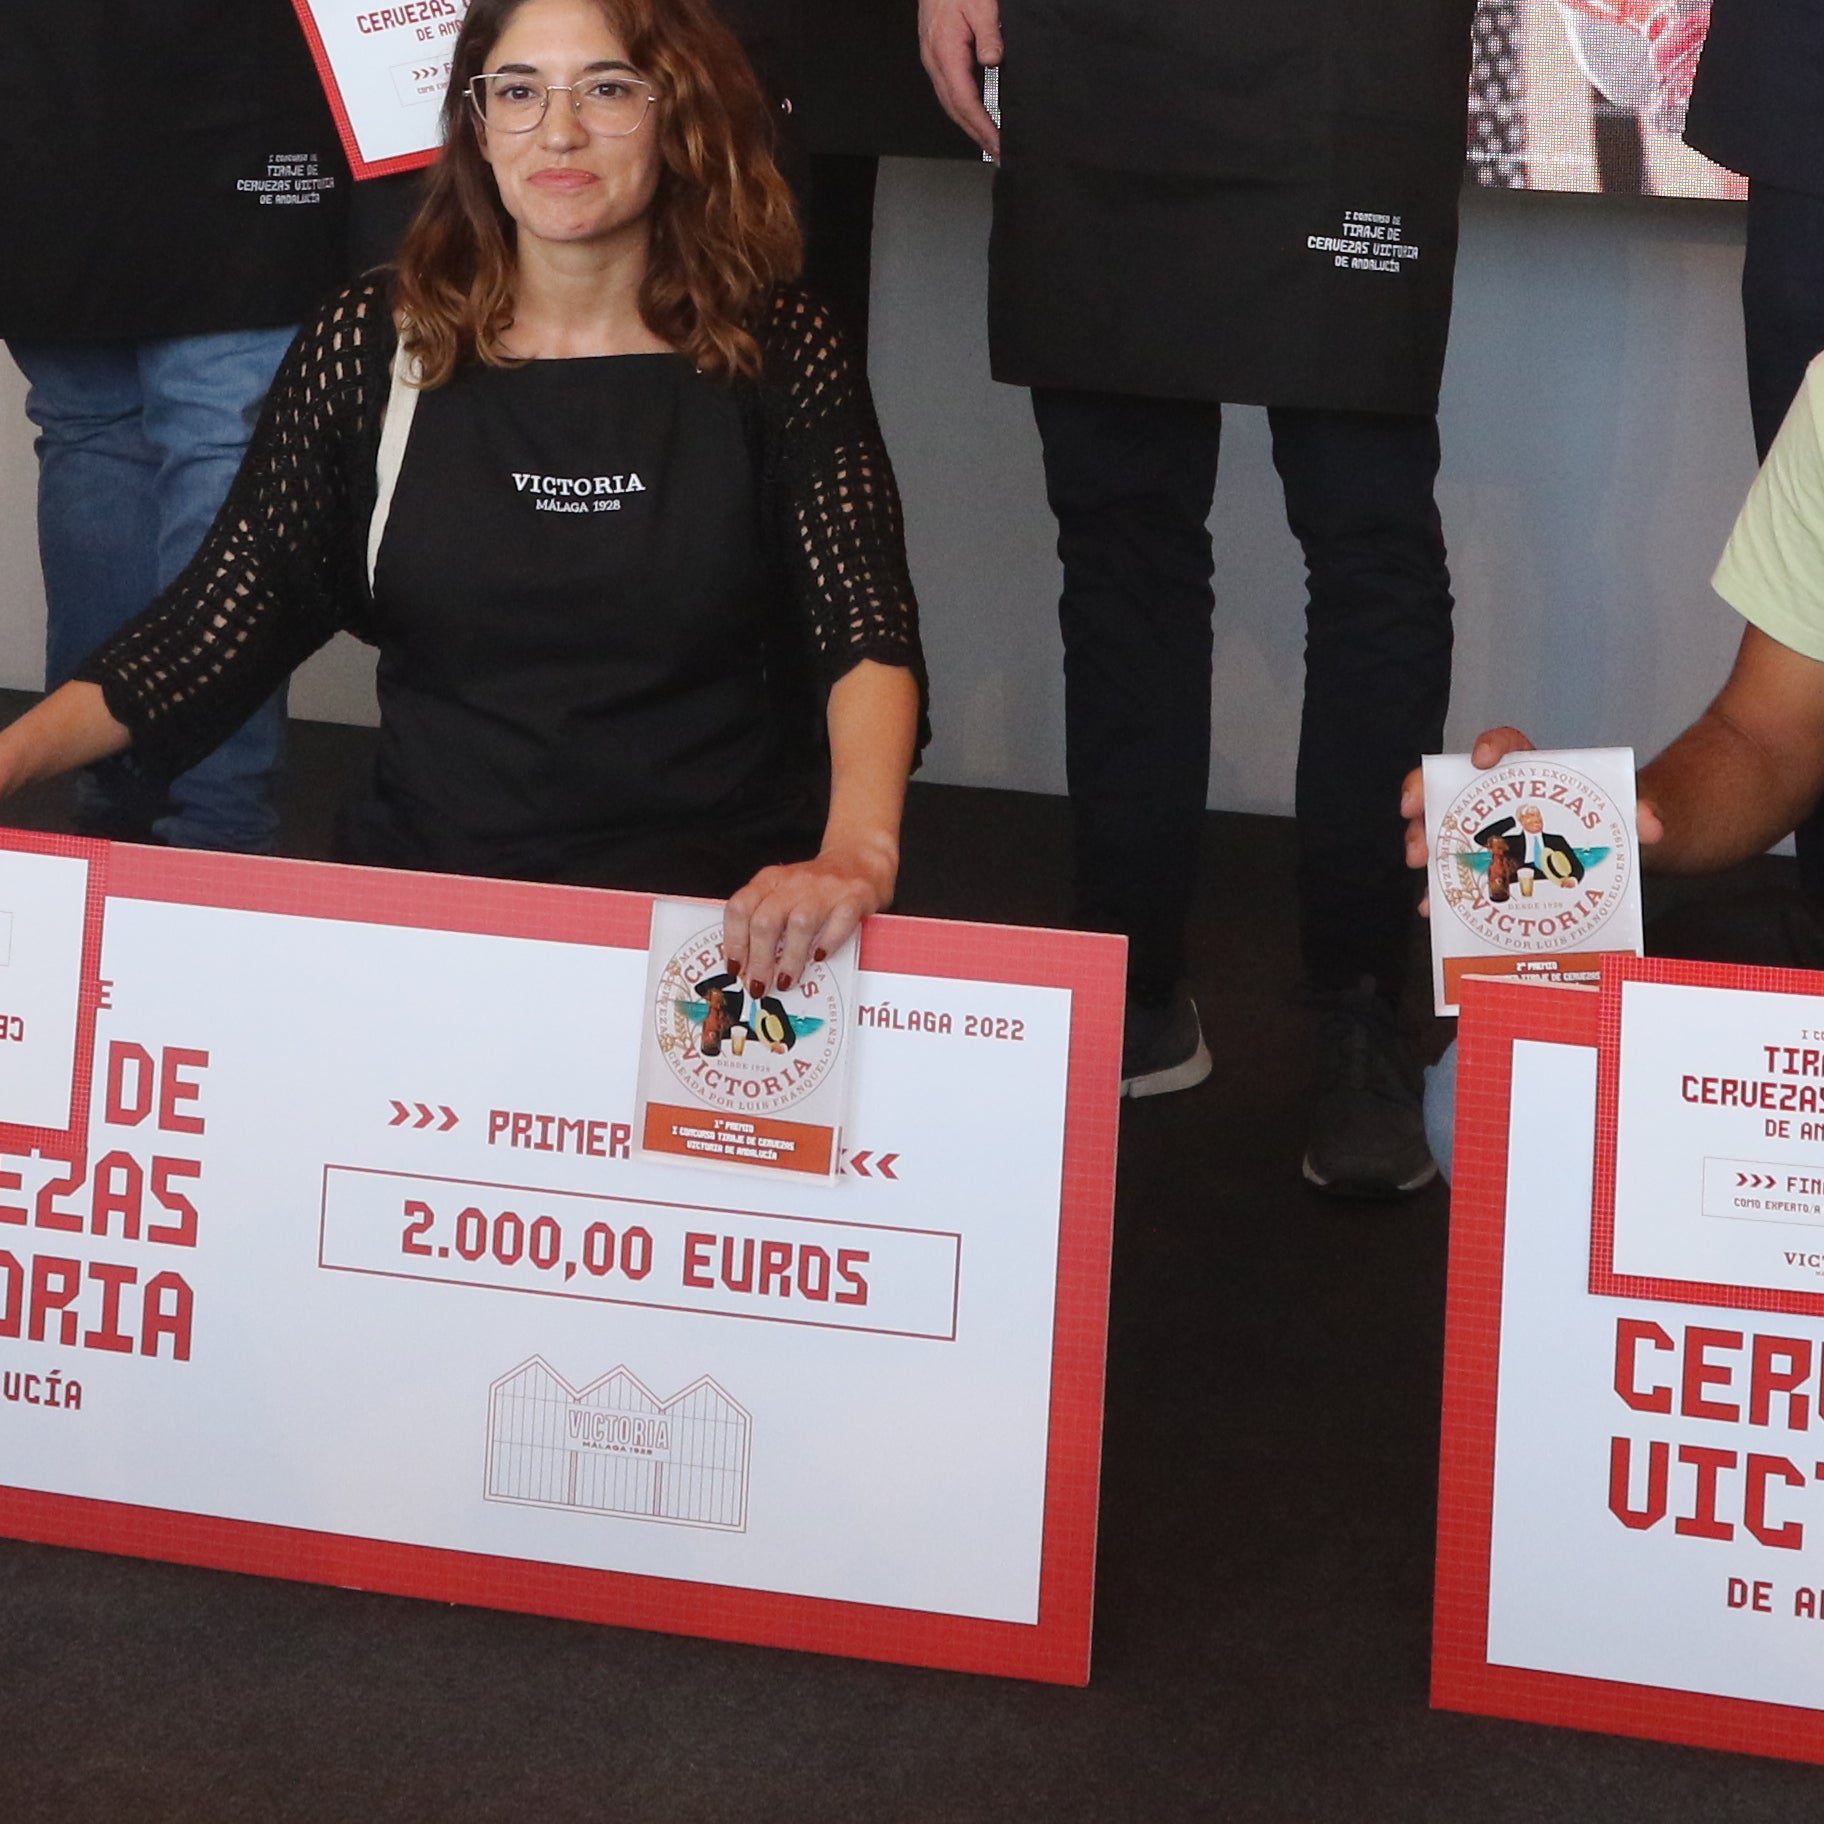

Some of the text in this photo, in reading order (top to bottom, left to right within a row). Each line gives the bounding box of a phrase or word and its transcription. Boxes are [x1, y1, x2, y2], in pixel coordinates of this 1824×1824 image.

[1308, 236, 1418, 259] CERVEZAS VICTORIA
[1343, 223, 1401, 241] TIRAJE DE
[1335, 256, 1349, 267] DE
[512, 474, 646, 496] VICTORIA
[536, 498, 620, 512] MÁLAGA 1928
[1461, 780, 1601, 835] CERVEZAS
[1471, 887, 1604, 937] VICTORIA
[858, 998, 1024, 1041] MÁLAGA 2022
[104, 1041, 209, 1135] DE
[682, 1046, 811, 1098] VICTORIA
[488, 1109, 631, 1160] PRIMER
[1764, 1118, 1790, 1138] DE
[401, 1200, 869, 1306] 2.000,00 EUROS
[569, 1410, 668, 1449] VICTORIA
[1727, 1576, 1773, 1613] DE
